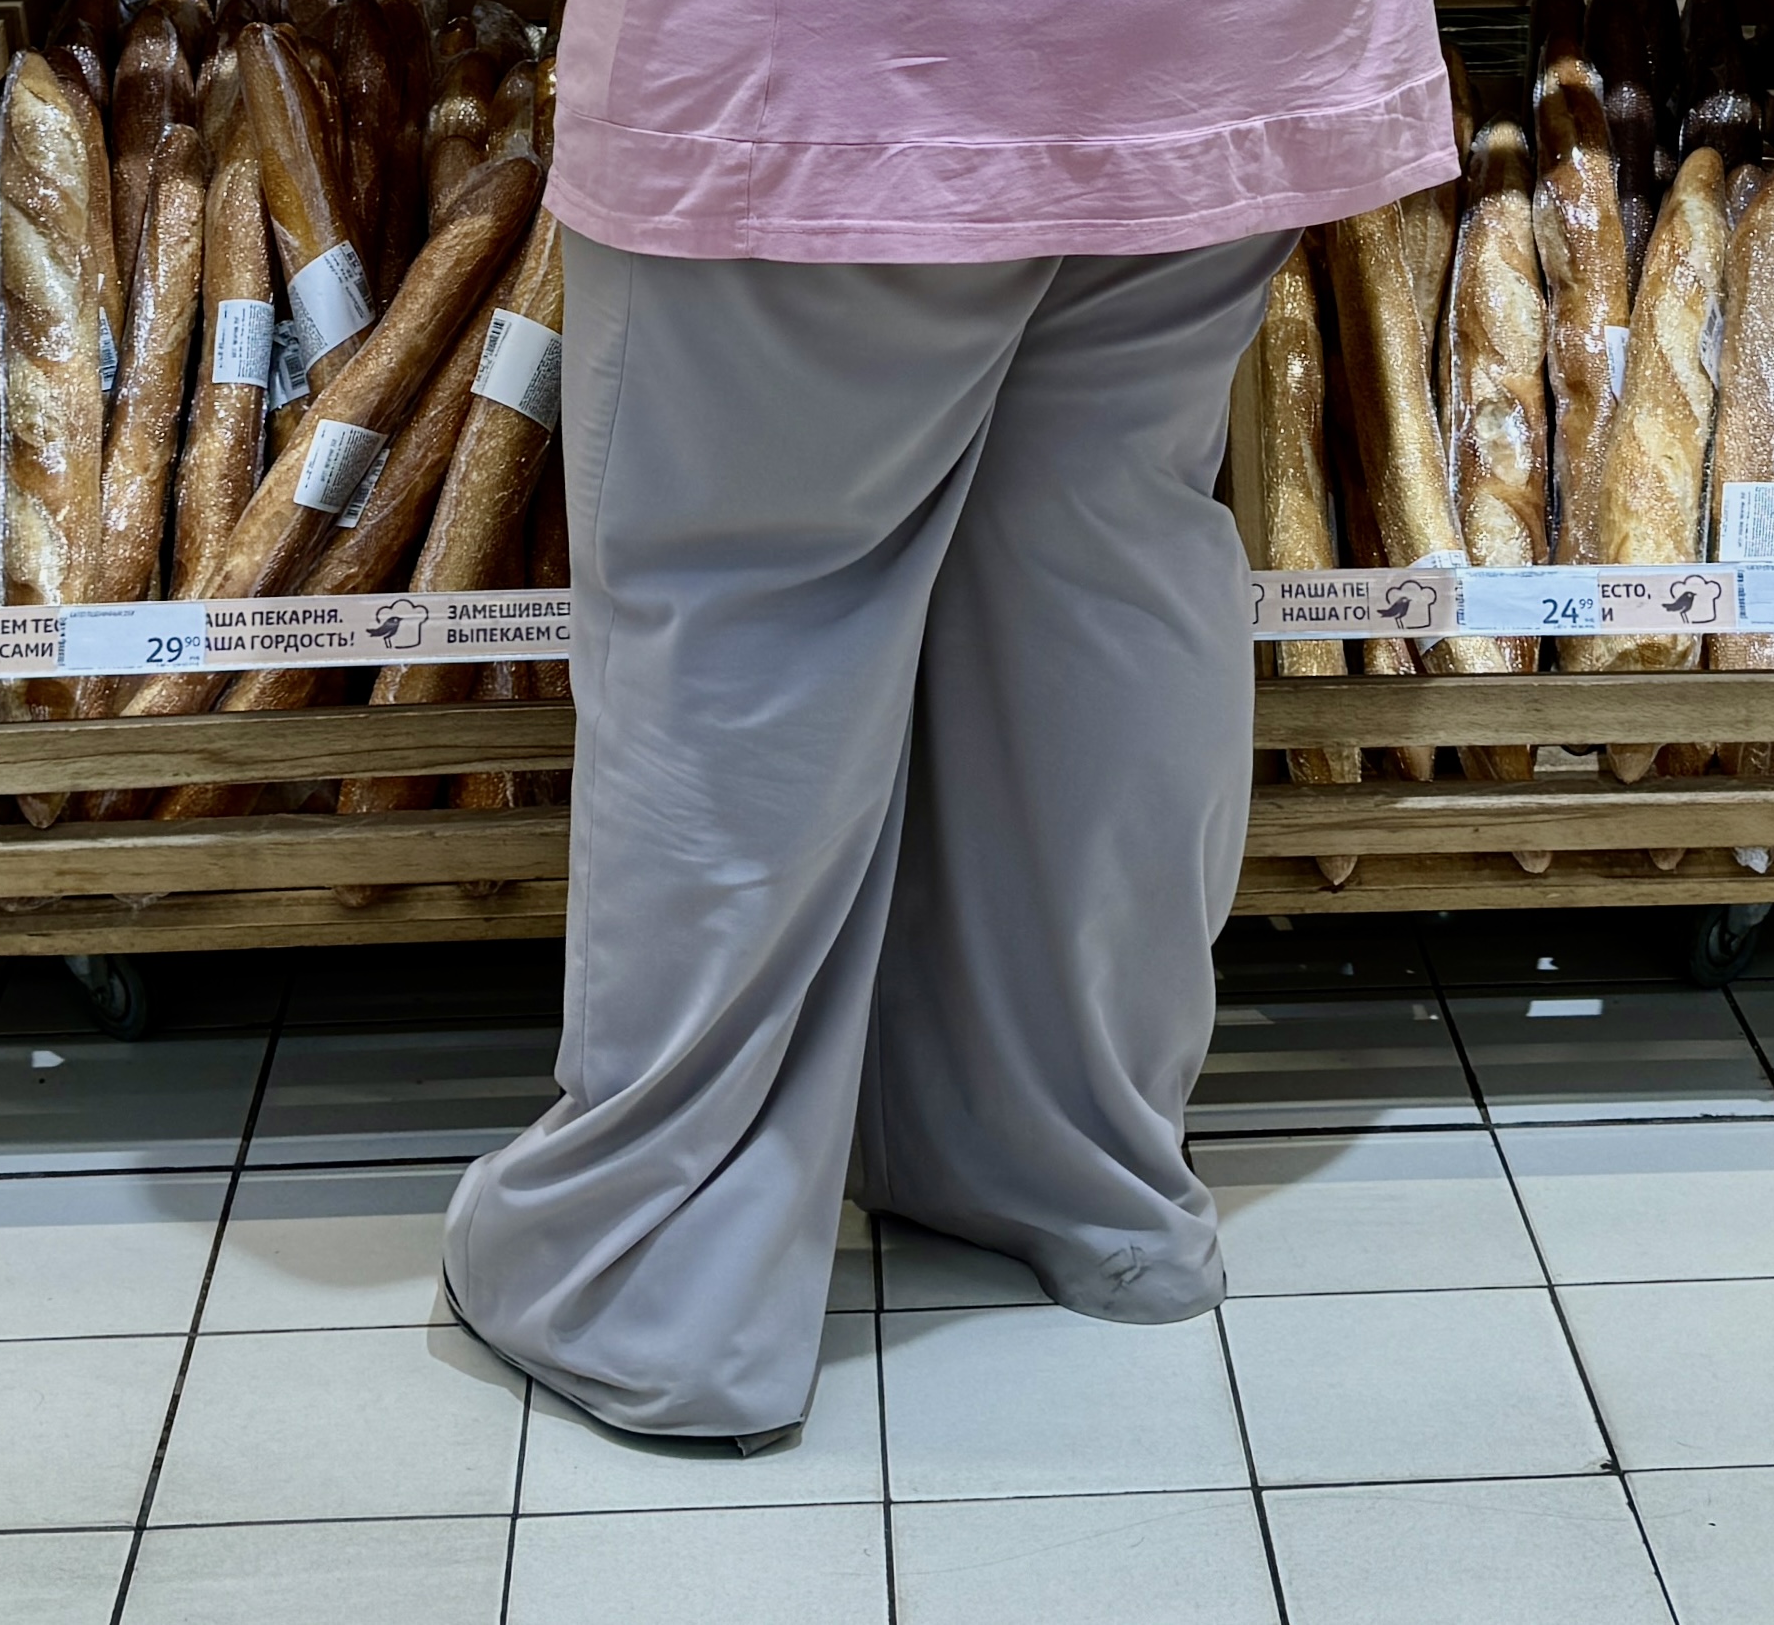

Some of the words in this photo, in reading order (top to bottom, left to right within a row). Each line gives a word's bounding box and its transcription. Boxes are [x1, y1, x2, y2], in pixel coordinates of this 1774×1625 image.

[252, 609, 343, 626] ПЕКАРНЯ.
[251, 632, 354, 653] ГОРДОСТЬ!
[447, 626, 550, 643] ВЫПЕКАЕМ
[0, 643, 53, 658] САМИ
